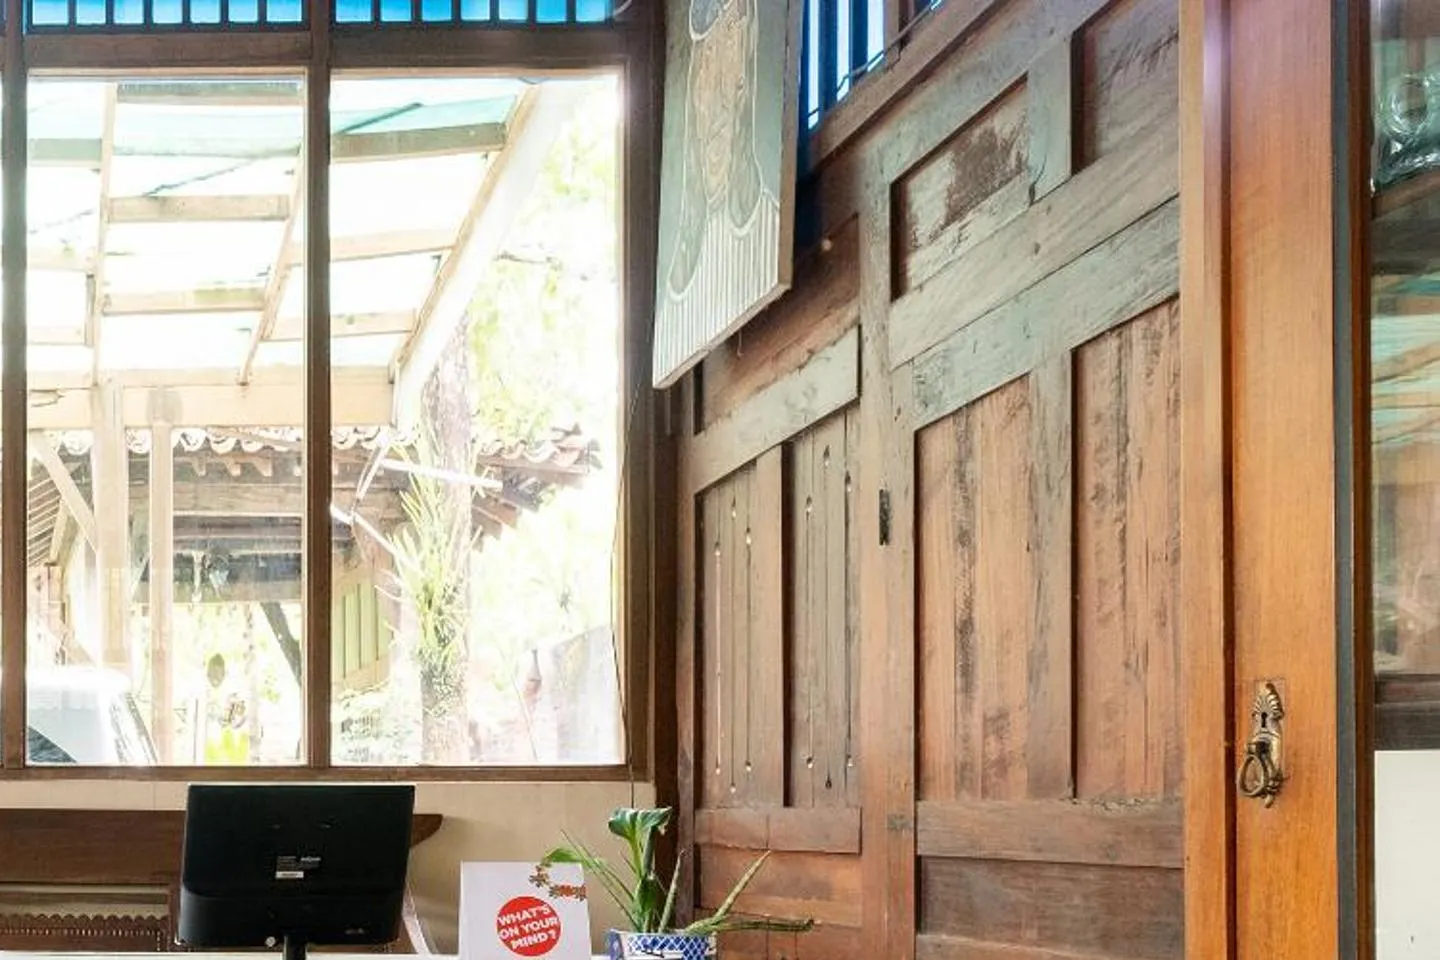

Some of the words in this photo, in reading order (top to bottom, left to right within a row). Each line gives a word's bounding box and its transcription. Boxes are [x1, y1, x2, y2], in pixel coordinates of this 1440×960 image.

[497, 904, 552, 926] WHAT'S
[499, 925, 520, 941] ON
[520, 917, 559, 934] YOUR
